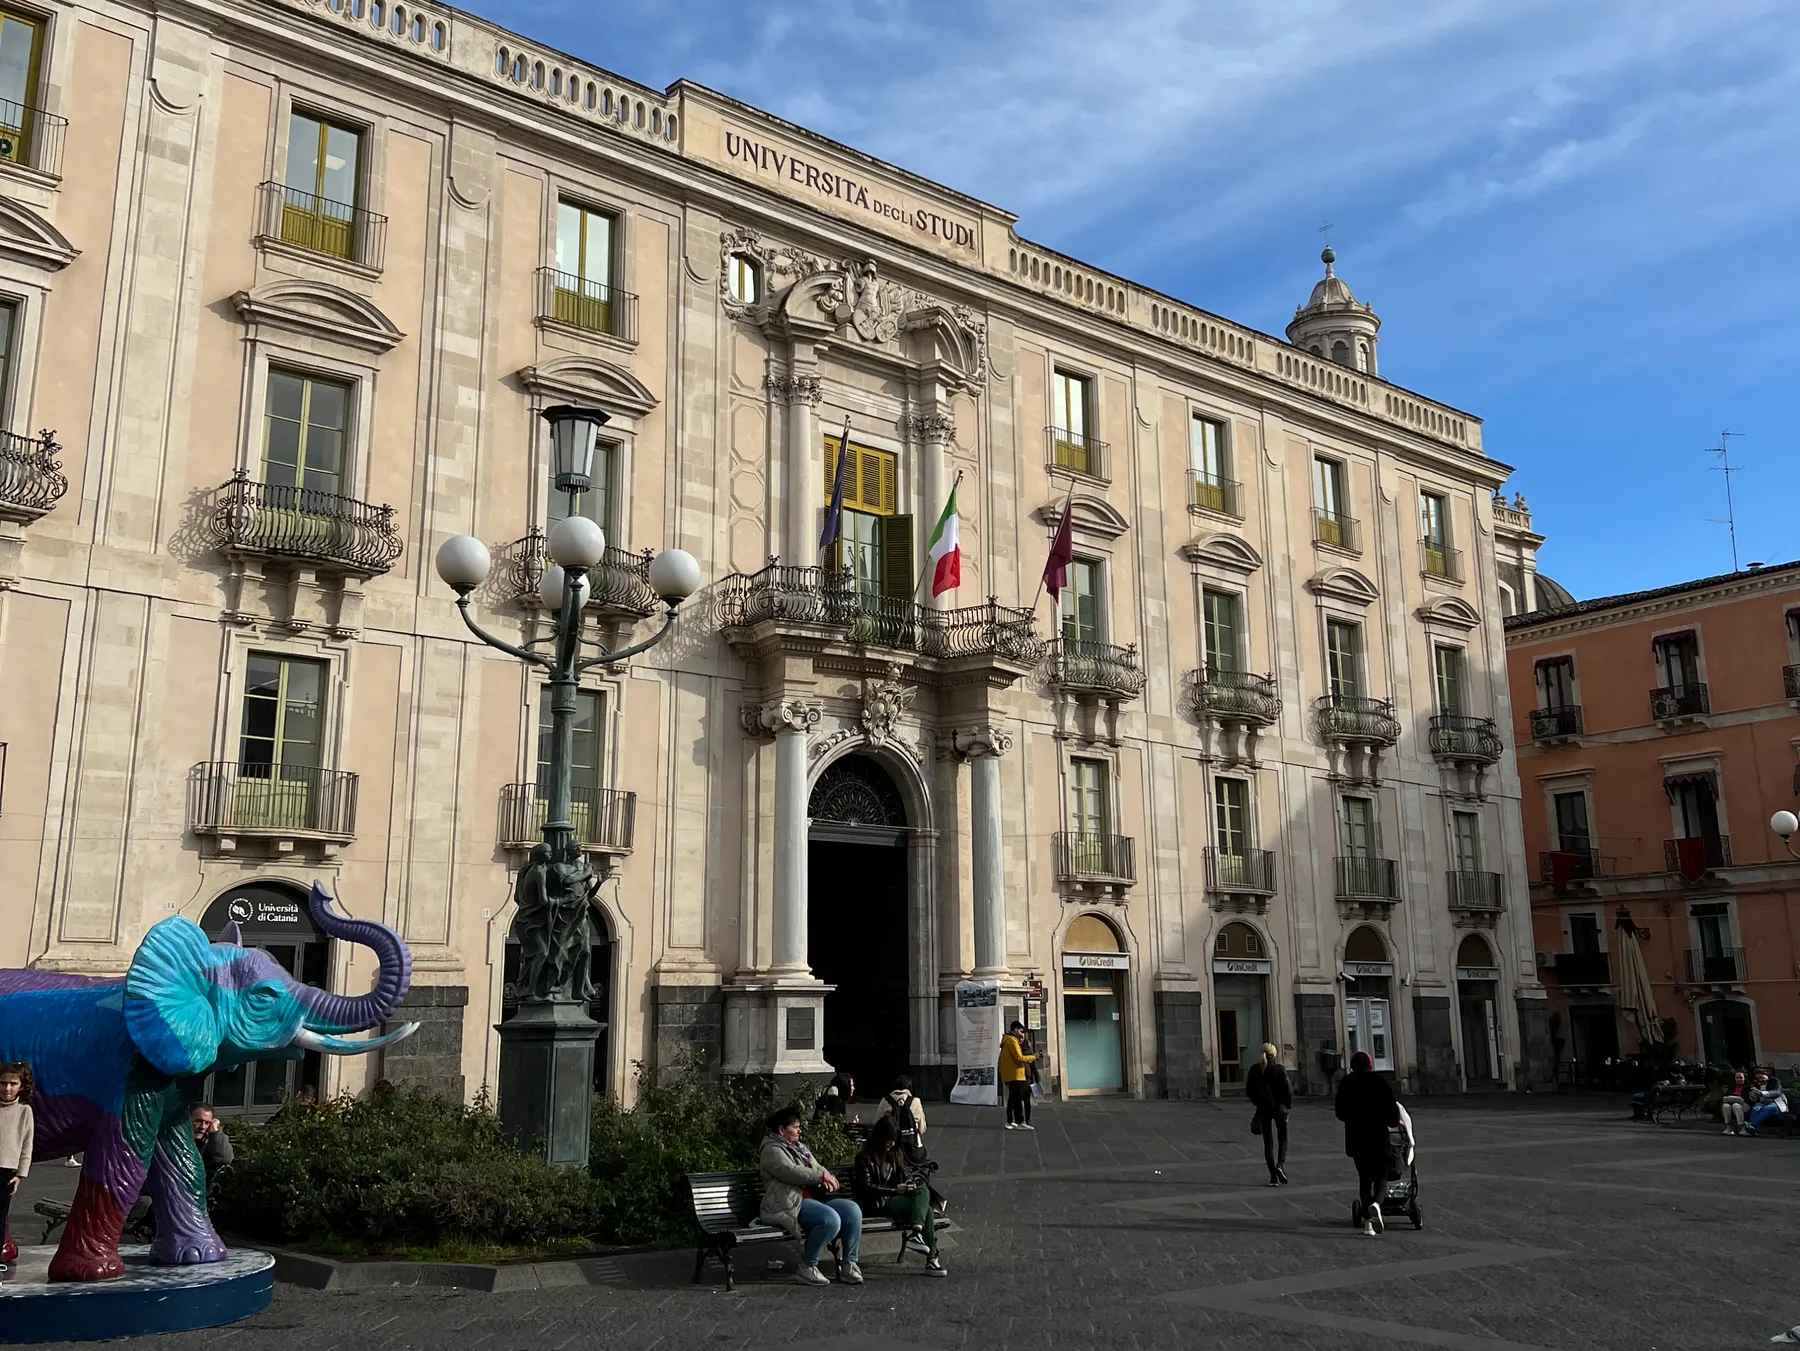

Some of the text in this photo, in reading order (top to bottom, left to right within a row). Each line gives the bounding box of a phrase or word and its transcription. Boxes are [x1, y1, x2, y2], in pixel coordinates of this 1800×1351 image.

[873, 199, 914, 227] DEGLI
[916, 209, 975, 250] STUDI
[258, 902, 299, 913] Università
[257, 913, 298, 923] di Catania
[1086, 957, 1114, 967] UniCredit
[1234, 962, 1258, 972] UniCredit
